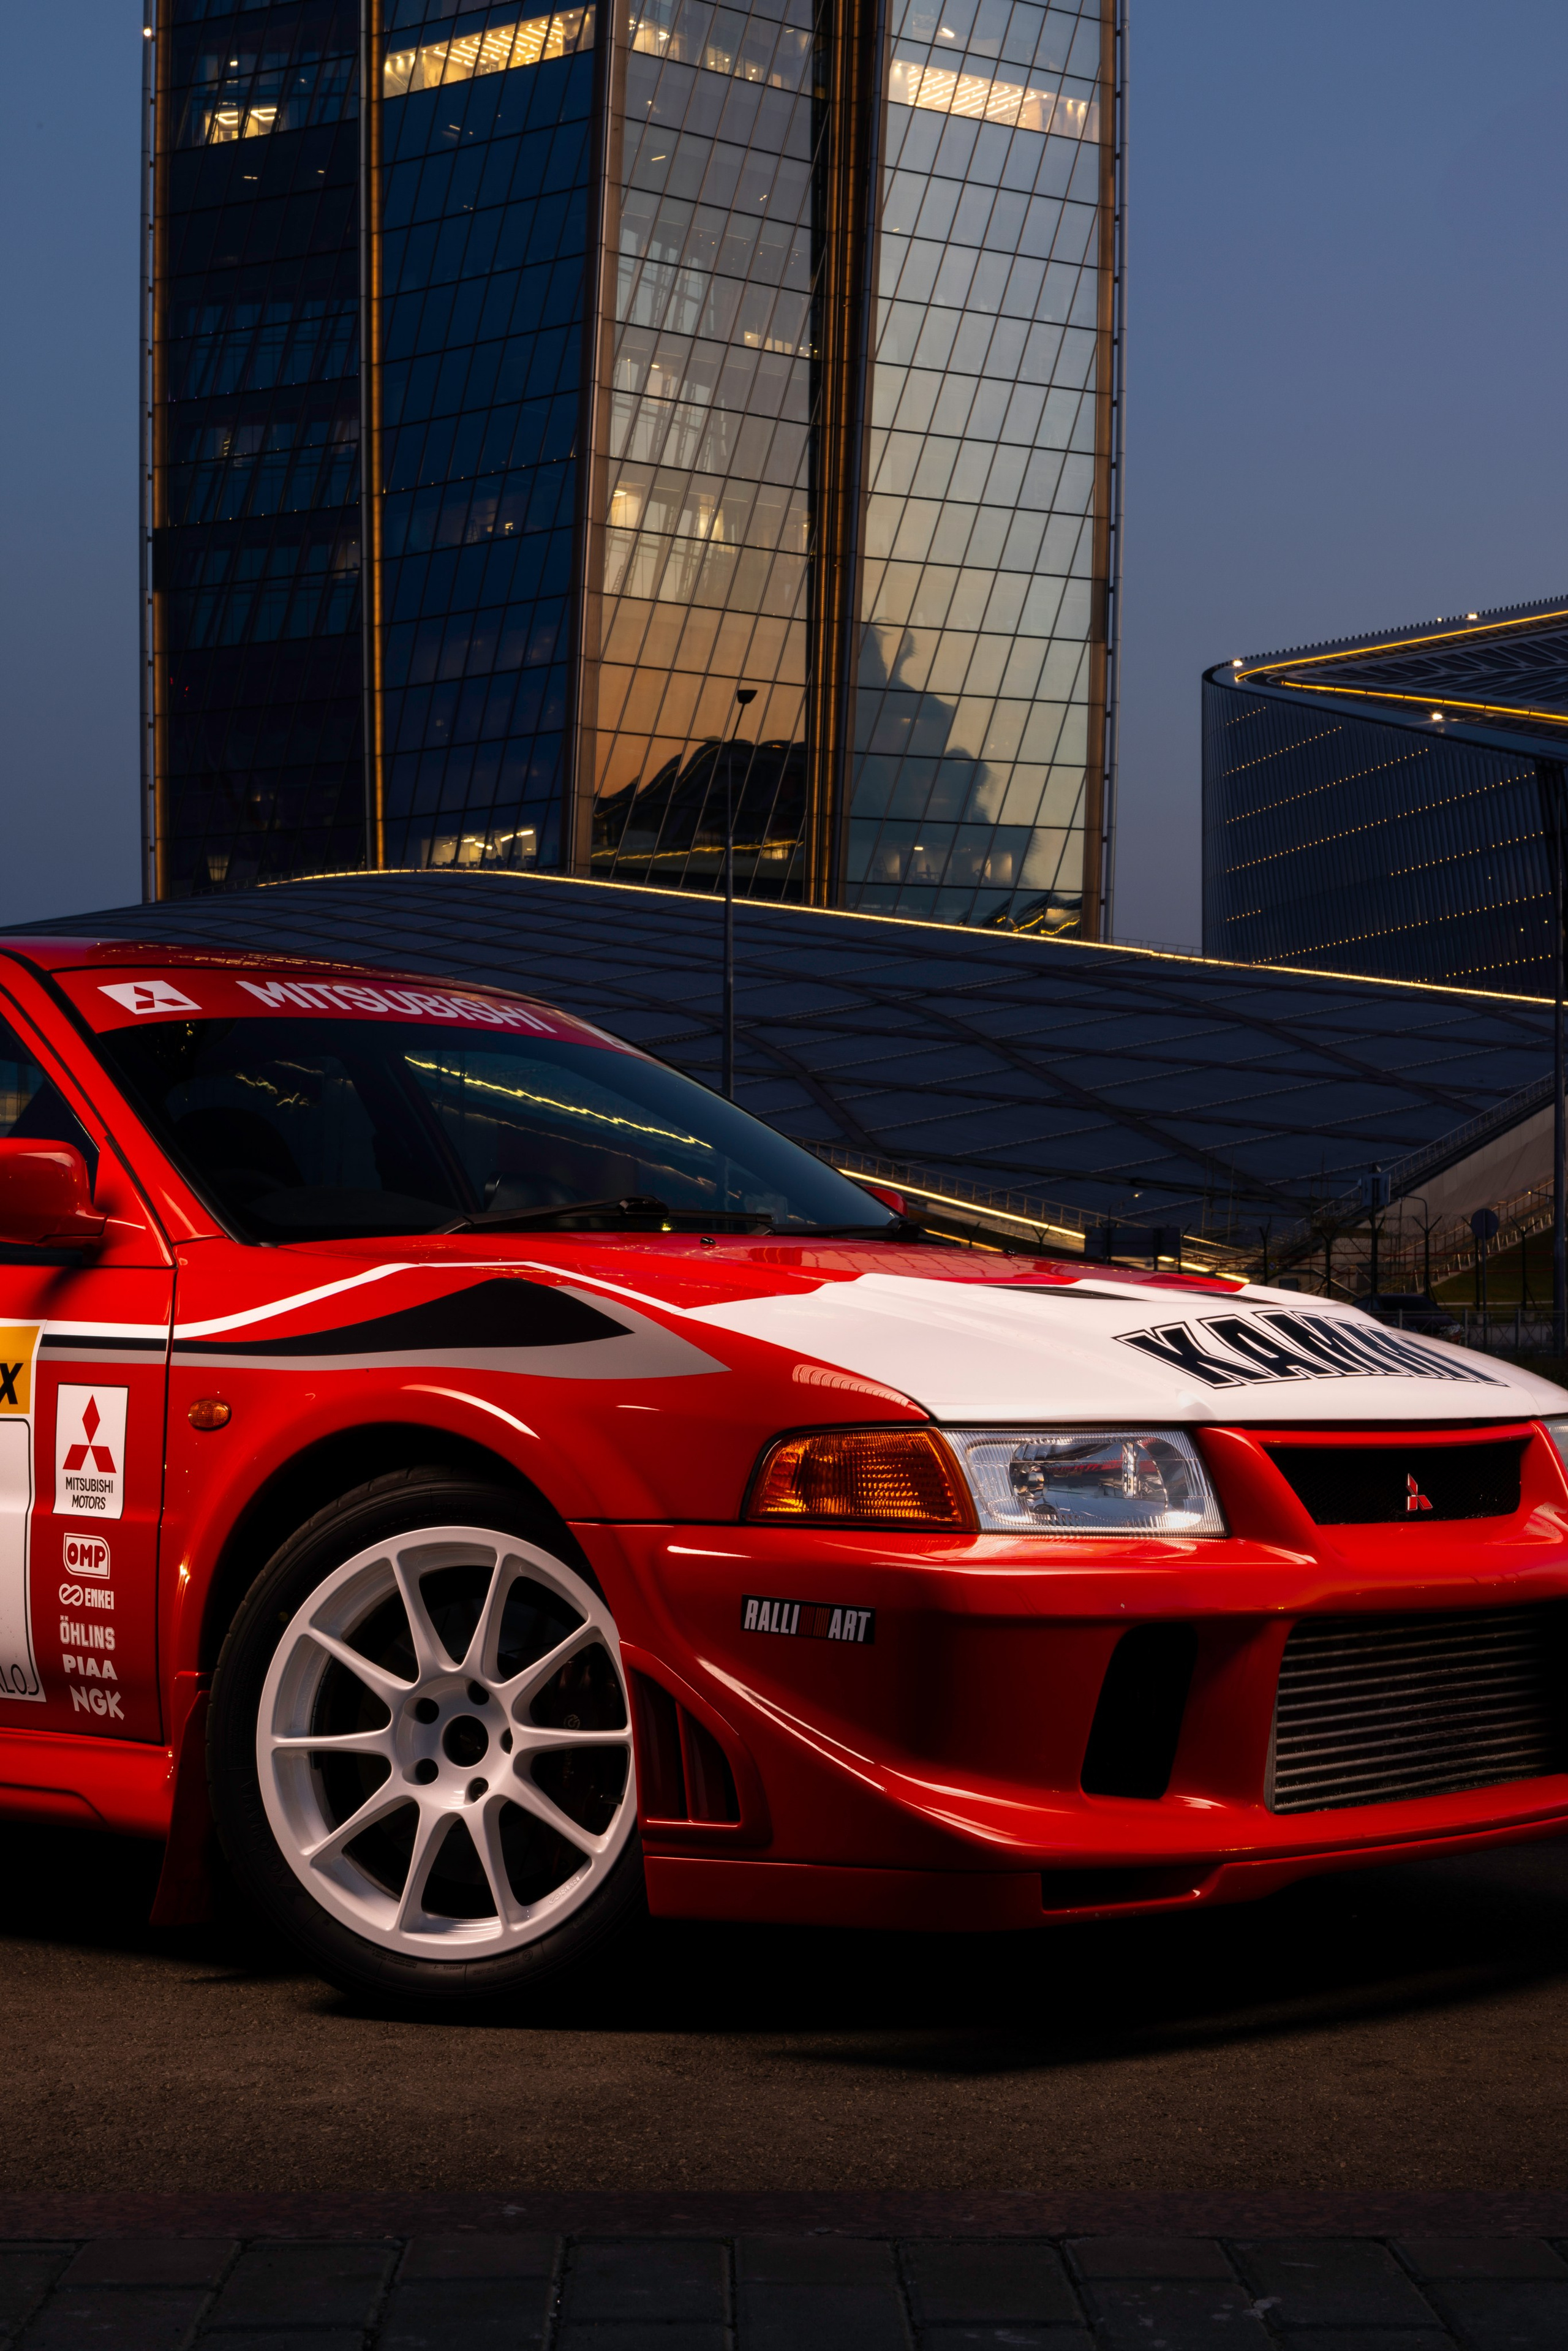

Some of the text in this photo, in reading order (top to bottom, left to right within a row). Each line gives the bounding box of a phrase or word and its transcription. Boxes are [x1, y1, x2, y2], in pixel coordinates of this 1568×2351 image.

[235, 980, 557, 1033] MITSUBISHI
[66, 1476, 113, 1493] MITSUBISHI
[72, 1495, 106, 1510] MOTORS
[67, 1542, 106, 1568] OMP
[85, 1587, 115, 1610] ENKEI
[59, 1615, 116, 1651] ÖHLINS
[62, 1654, 118, 1680] PIAA
[69, 1685, 125, 1720] NGK
